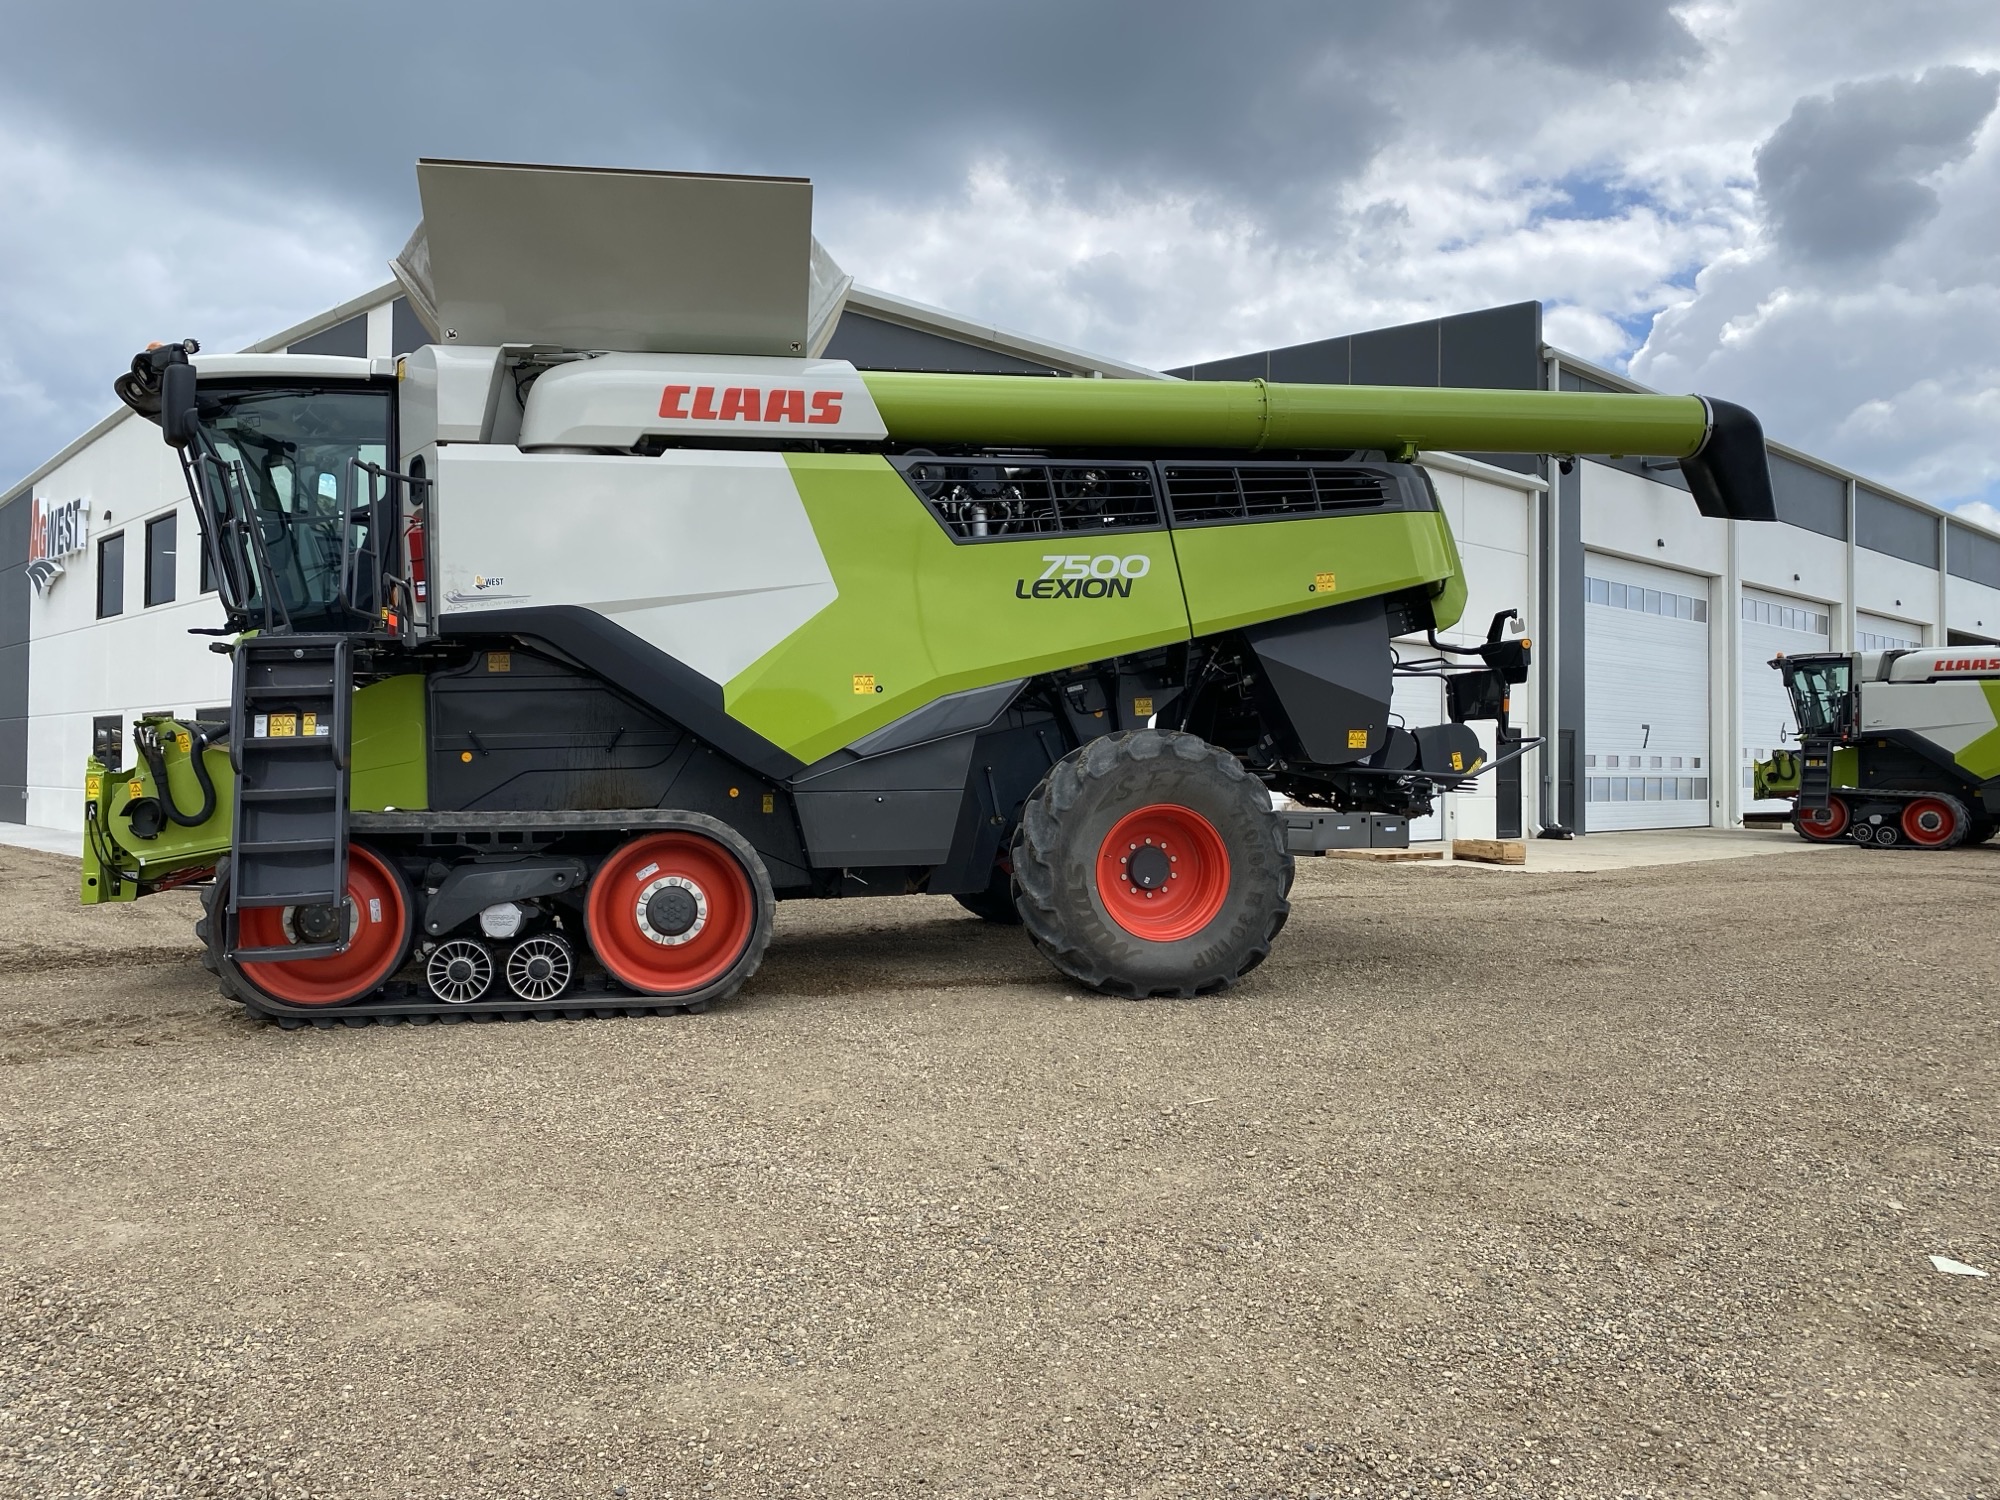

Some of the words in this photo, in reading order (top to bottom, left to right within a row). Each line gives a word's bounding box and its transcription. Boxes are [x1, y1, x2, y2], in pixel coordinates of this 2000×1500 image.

[658, 385, 844, 425] CLAAS
[1040, 554, 1151, 579] 7500
[1015, 578, 1133, 599] LEXION
[1934, 658, 2000, 672] CLAAS
[1641, 724, 1650, 748] 7
[1780, 722, 1787, 743] 6
